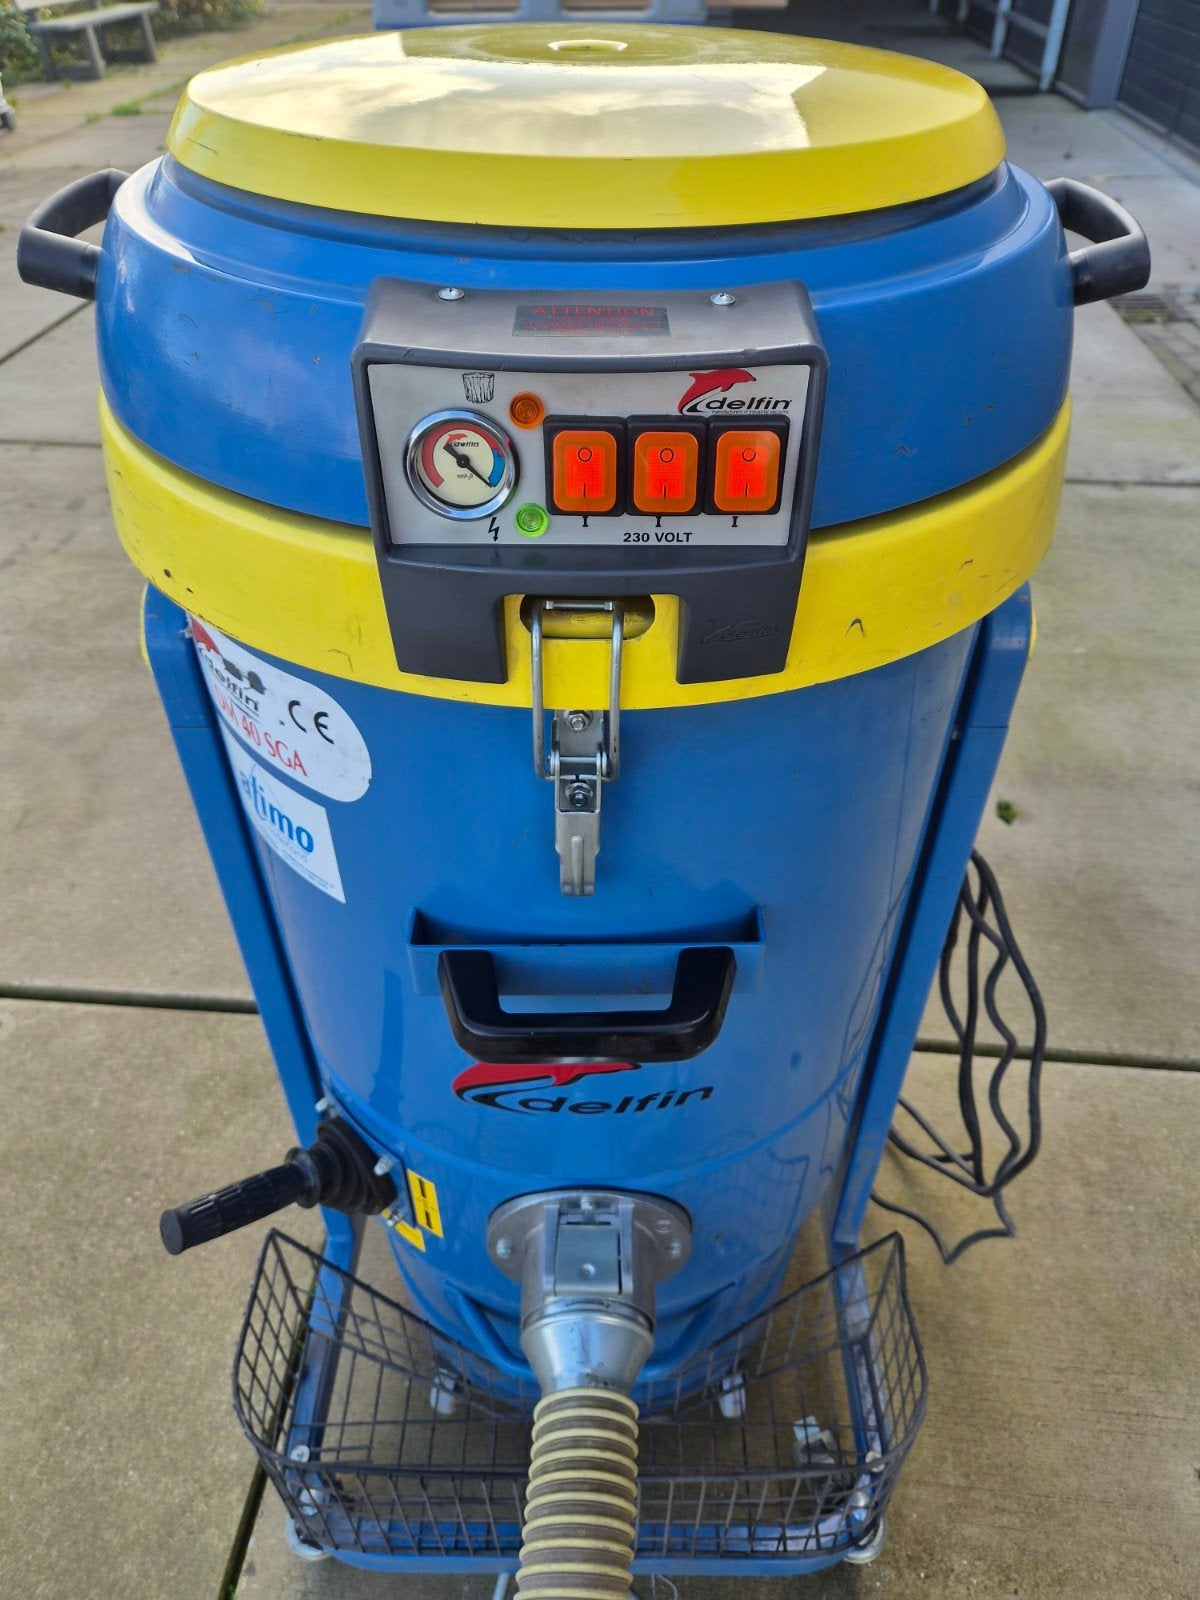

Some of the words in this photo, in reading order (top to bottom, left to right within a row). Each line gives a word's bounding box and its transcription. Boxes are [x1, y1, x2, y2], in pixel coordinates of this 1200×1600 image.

[532, 306, 654, 316] ATTENTION
[705, 397, 790, 410] delfin
[623, 532, 650, 543] 230
[655, 532, 693, 543] VOLT
[288, 700, 335, 745] CE
[264, 731, 309, 778] SGA
[518, 1085, 715, 1115] delfin
